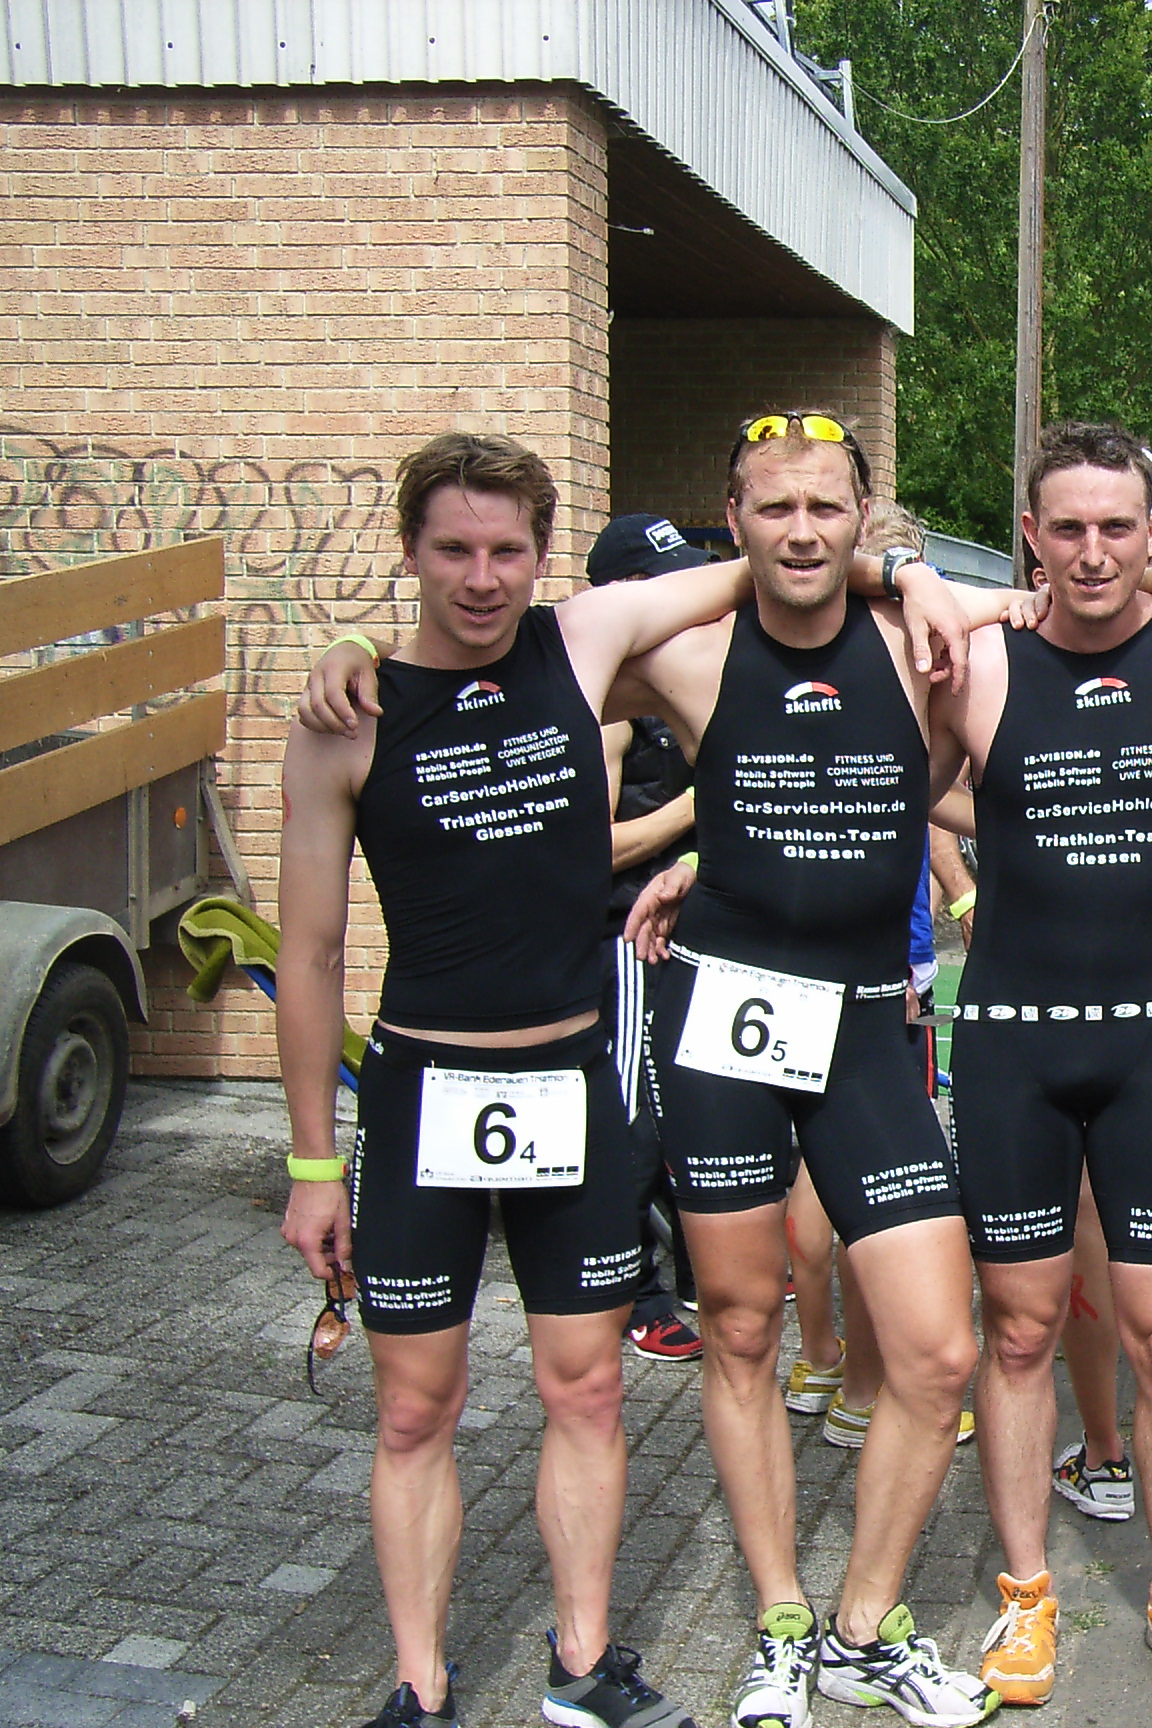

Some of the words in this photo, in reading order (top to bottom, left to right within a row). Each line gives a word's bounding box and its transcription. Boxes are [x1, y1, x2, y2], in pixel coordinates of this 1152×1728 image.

[457, 692, 506, 711] skinfit
[785, 698, 842, 714] skinfit
[1076, 691, 1131, 709] skinfit
[504, 732, 538, 747] FITNESS
[540, 726, 558, 738] UND
[498, 733, 569, 759] COMMUNICATION
[506, 757, 527, 768] UWE
[529, 746, 566, 763] WEIGERT
[835, 755, 873, 764] FITNESS
[877, 754, 894, 762] UND
[416, 764, 447, 774] Mobile
[450, 756, 490, 770] Software
[827, 766, 903, 776] COMMUNICATION
[426, 772, 458, 783] Mobile
[460, 765, 491, 777] People
[735, 770, 766, 778] Mobile
[770, 770, 815, 778] Software
[1024, 770, 1056, 781] Mobile
[1060, 767, 1101, 776] Software
[1119, 771, 1140, 780] UWE
[421, 766, 576, 808] CarServiceHohler.de
[743, 780, 775, 788] Mobile
[780, 780, 815, 789] People
[835, 779, 858, 787] UWE
[861, 777, 899, 786] WEIGERT
[1034, 780, 1065, 790] Mobile
[1068, 776, 1101, 786] People
[440, 797, 569, 830] Triathlon-Team
[734, 800, 906, 815] CarServiceHohler.de
[476, 821, 543, 841] Giessen
[746, 826, 897, 842] Triathlon-Team
[783, 846, 865, 859] Giessen
[1067, 852, 1141, 865] Giessen
[731, 998, 774, 1057] 6
[771, 1040, 787, 1062] 5
[444, 1073, 481, 1083] VR-Bank
[474, 1102, 517, 1164] 6
[520, 1141, 536, 1163] 4
[730, 1166, 774, 1178] Software
[742, 1174, 774, 1185] People
[917, 1182, 949, 1193] People
[1023, 1218, 1062, 1232] Software
[995, 1234, 1030, 1242] Mobile
[1034, 1226, 1063, 1238] People
[590, 1277, 622, 1286] Mobile
[417, 1297, 452, 1308] People
